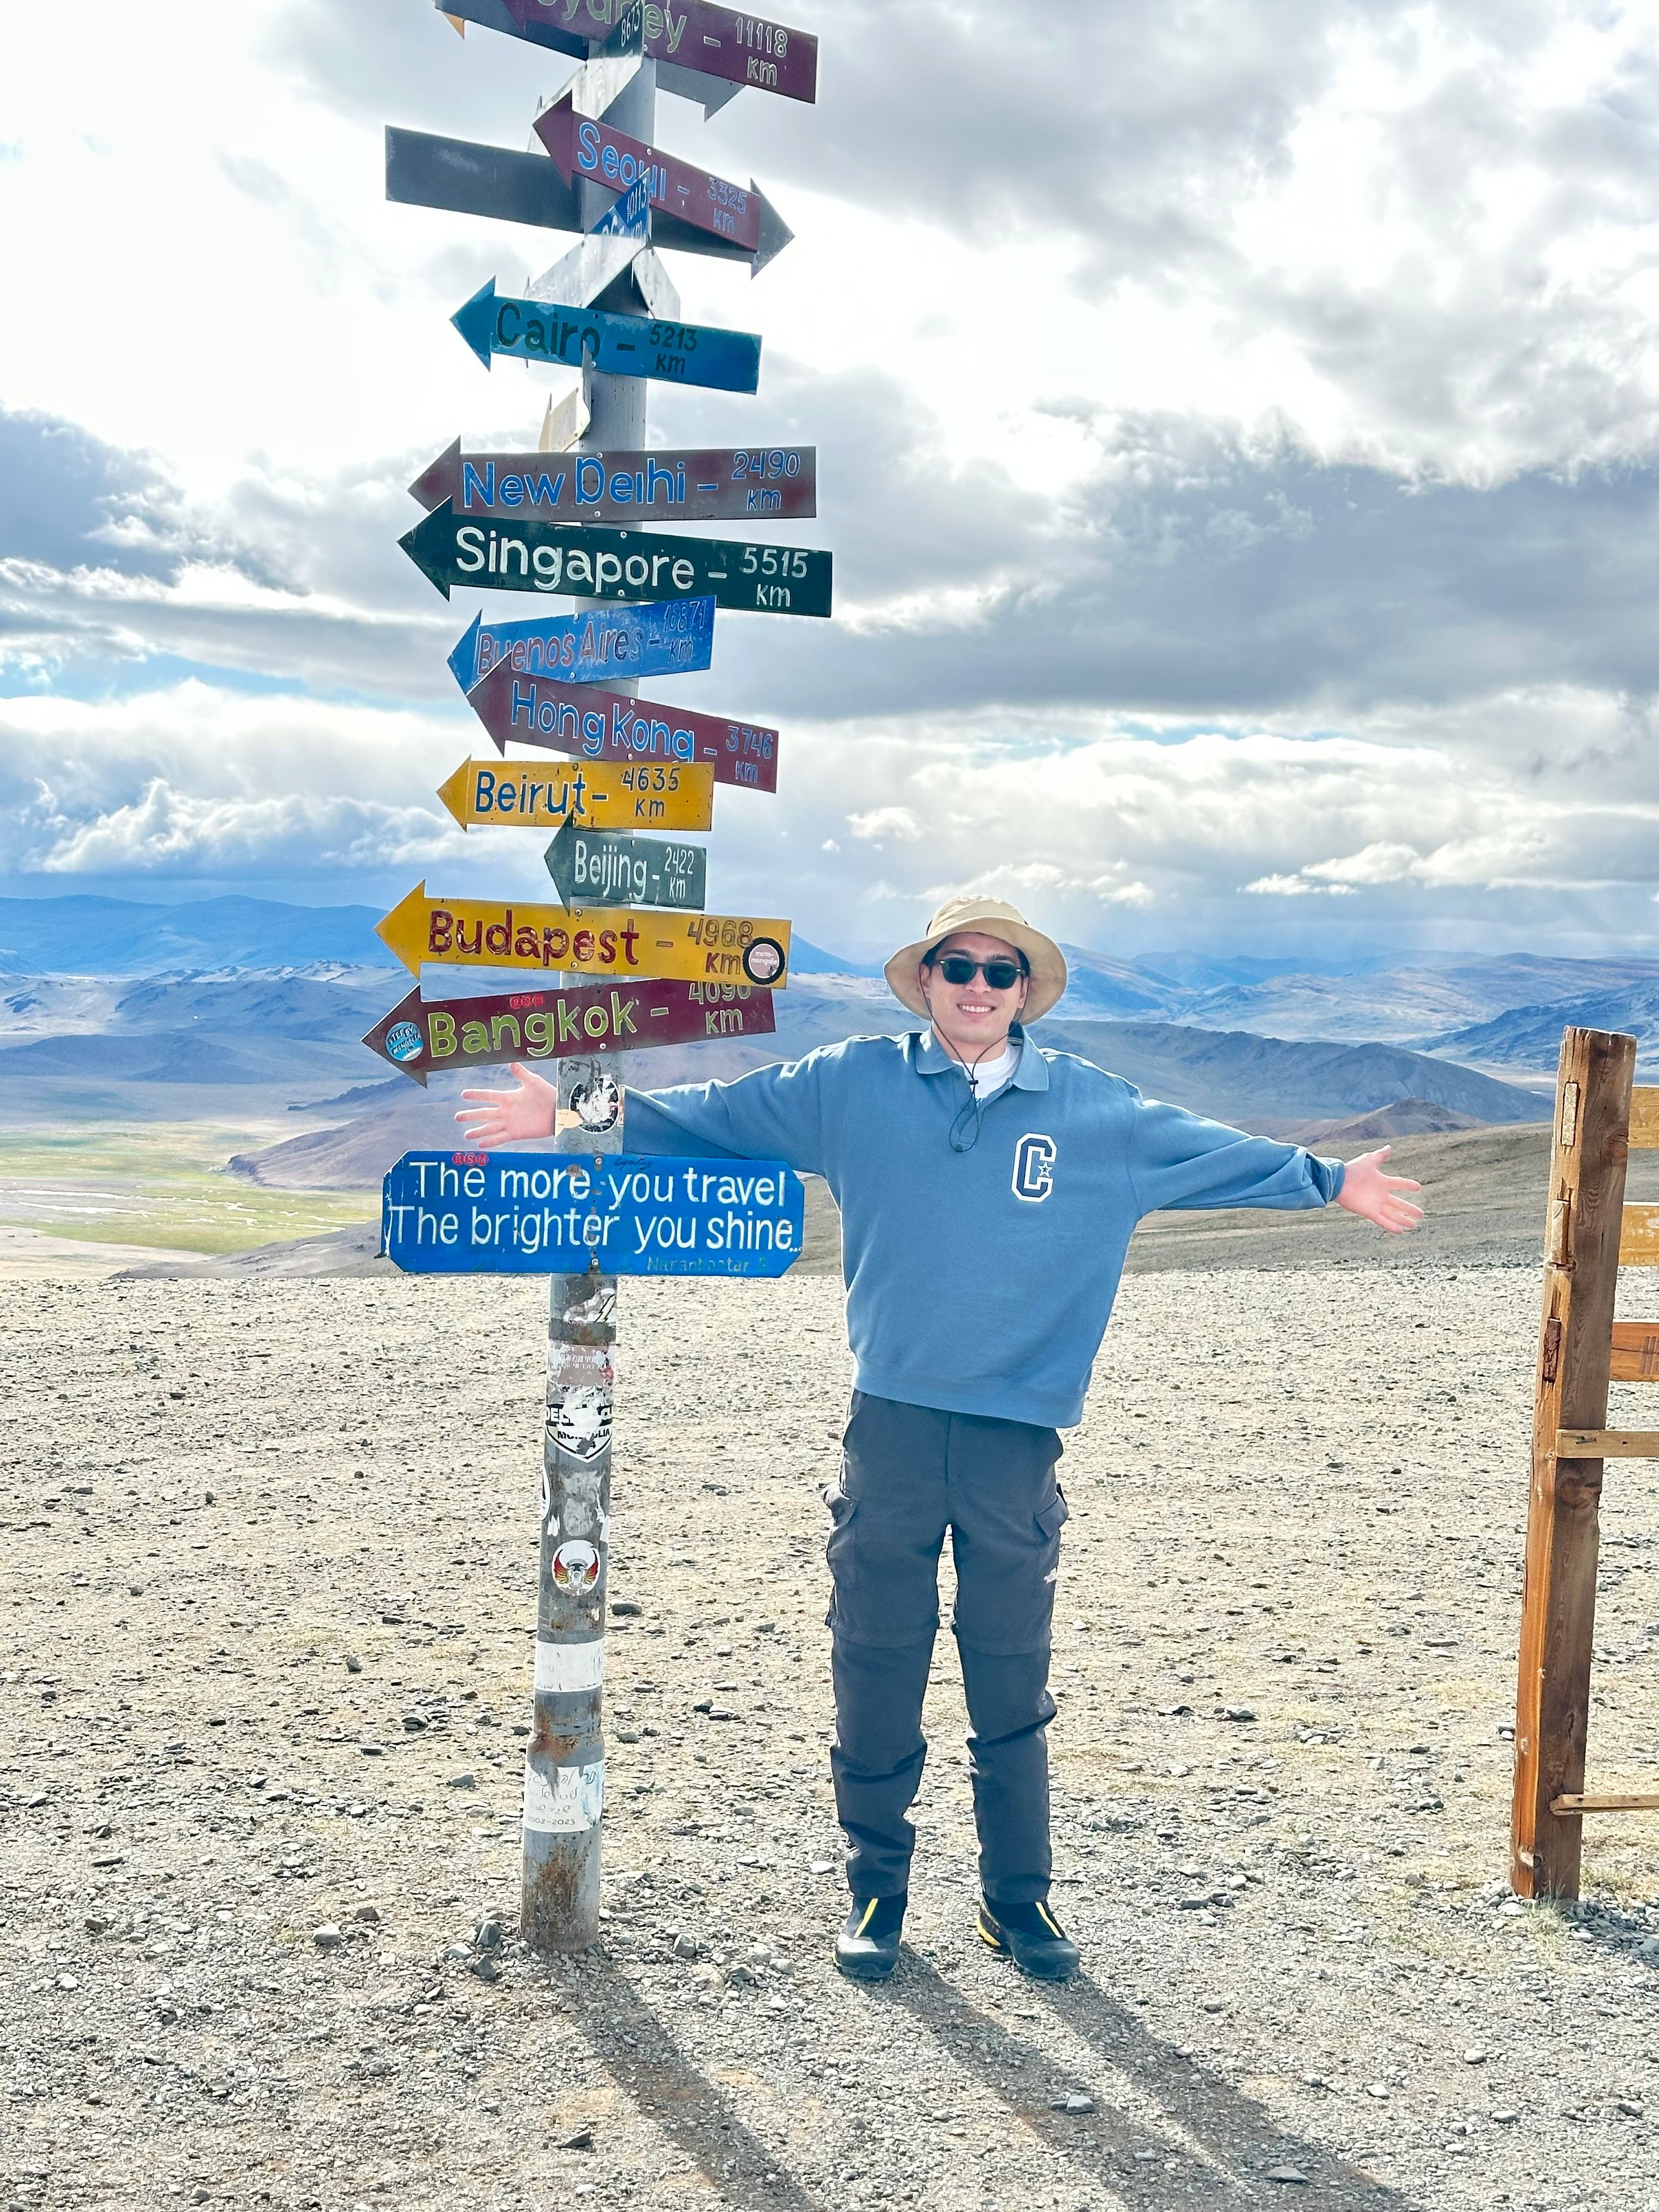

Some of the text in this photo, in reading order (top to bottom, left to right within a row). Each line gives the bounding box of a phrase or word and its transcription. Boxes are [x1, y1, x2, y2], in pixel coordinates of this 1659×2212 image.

[735, 17, 788, 58] 11118
[706, 176, 748, 215] 3325
[496, 301, 601, 360] Cairo
[648, 323, 698, 353] 5213
[462, 461, 565, 508] New
[575, 456, 686, 505] Delhi
[731, 449, 801, 480] 2490
[456, 526, 695, 594] Singapore
[742, 547, 809, 579] 5515
[477, 633, 576, 675] Buenos
[579, 621, 646, 665] Aires
[512, 679, 606, 756] Hong
[612, 702, 695, 763] Kong
[725, 724, 773, 760] 3746
[474, 771, 587, 816] Beirut
[621, 767, 681, 792] 4635
[574, 839, 647, 900] Beijing
[664, 846, 695, 875] 2422
[428, 909, 640, 966] Budapest
[686, 918, 754, 949] 4968
[429, 991, 638, 1058] Bangkok
[688, 981, 751, 1005] 4090
[409, 1161, 787, 1210] The more you travel
[1011, 1132, 1058, 1203] C
[389, 1205, 459, 1245] The
[471, 1206, 620, 1255] brighter
[634, 1215, 696, 1255] you
